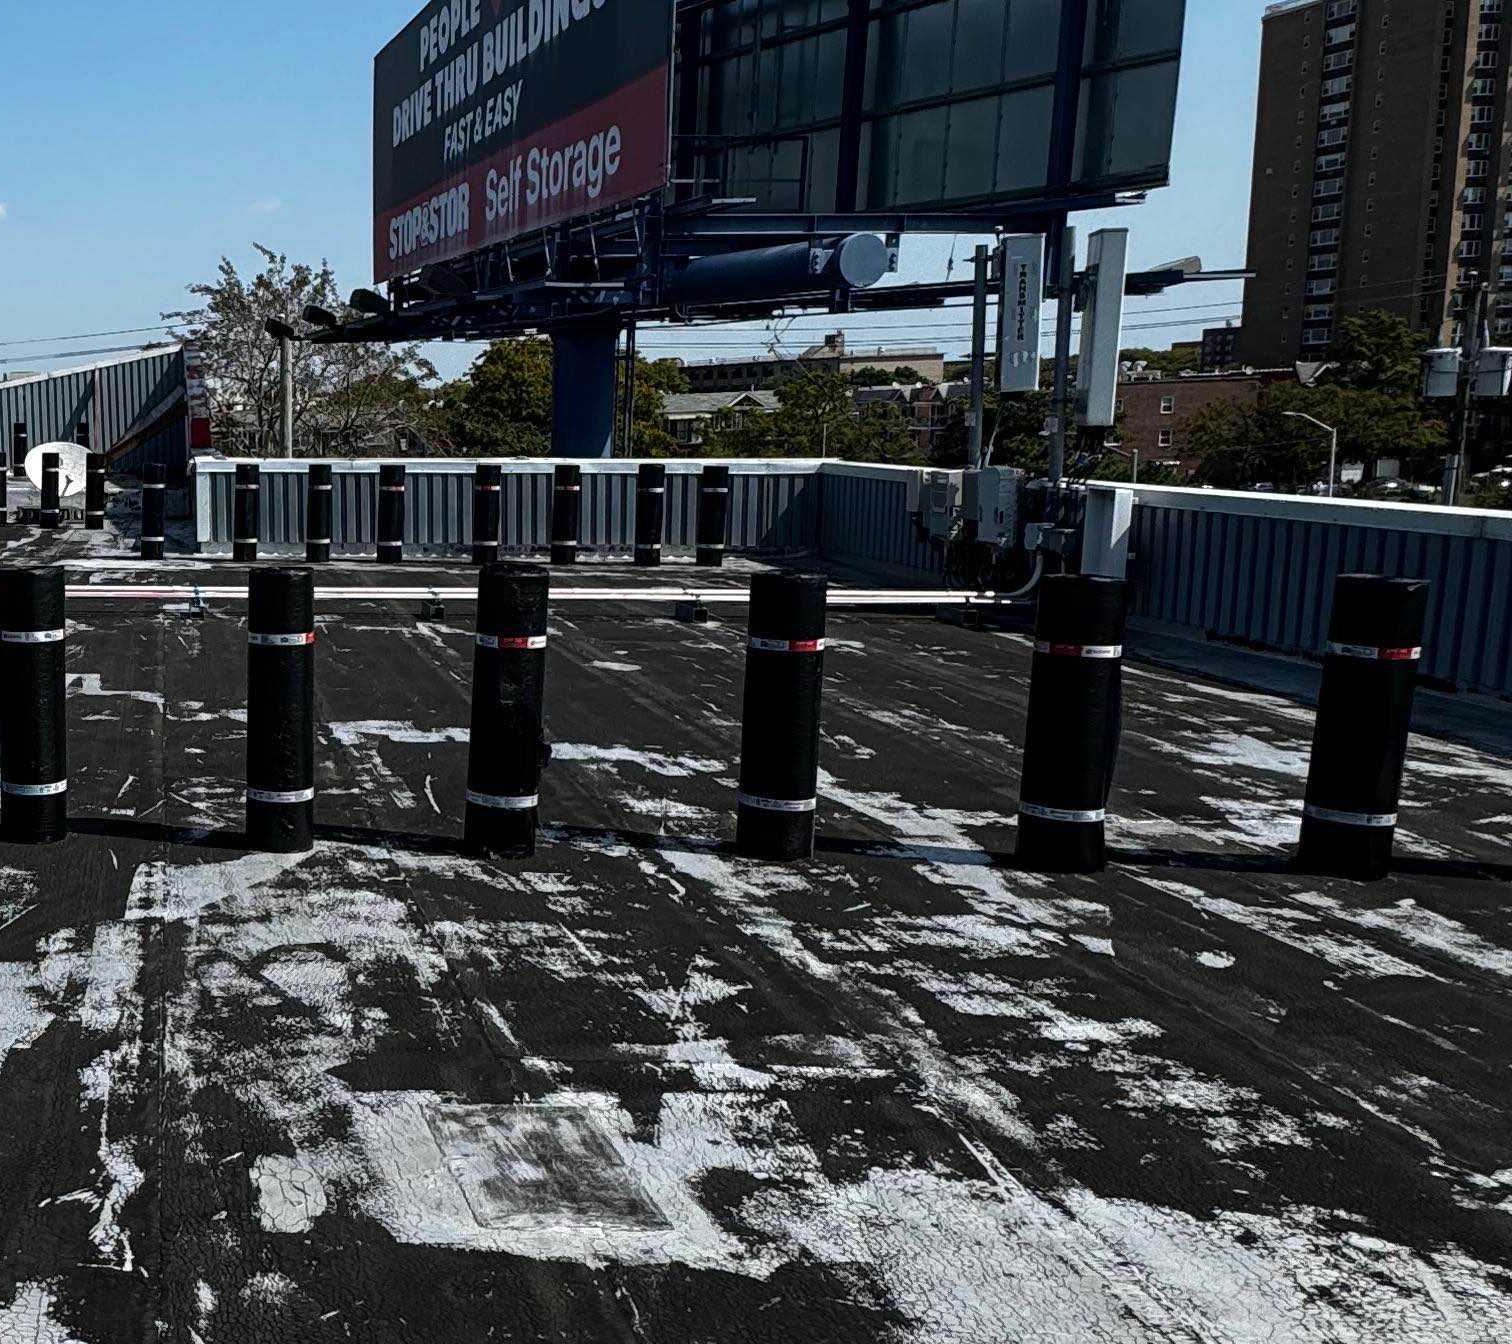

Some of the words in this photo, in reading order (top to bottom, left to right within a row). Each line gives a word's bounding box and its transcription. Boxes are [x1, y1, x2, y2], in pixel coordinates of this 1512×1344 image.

[392, 79, 432, 148] DRIVE
[435, 42, 479, 117] THRU
[443, 111, 474, 161] FAST
[473, 106, 482, 144] &
[485, 79, 524, 137] EASY
[485, 155, 522, 222] Self
[526, 124, 621, 206] Storage
